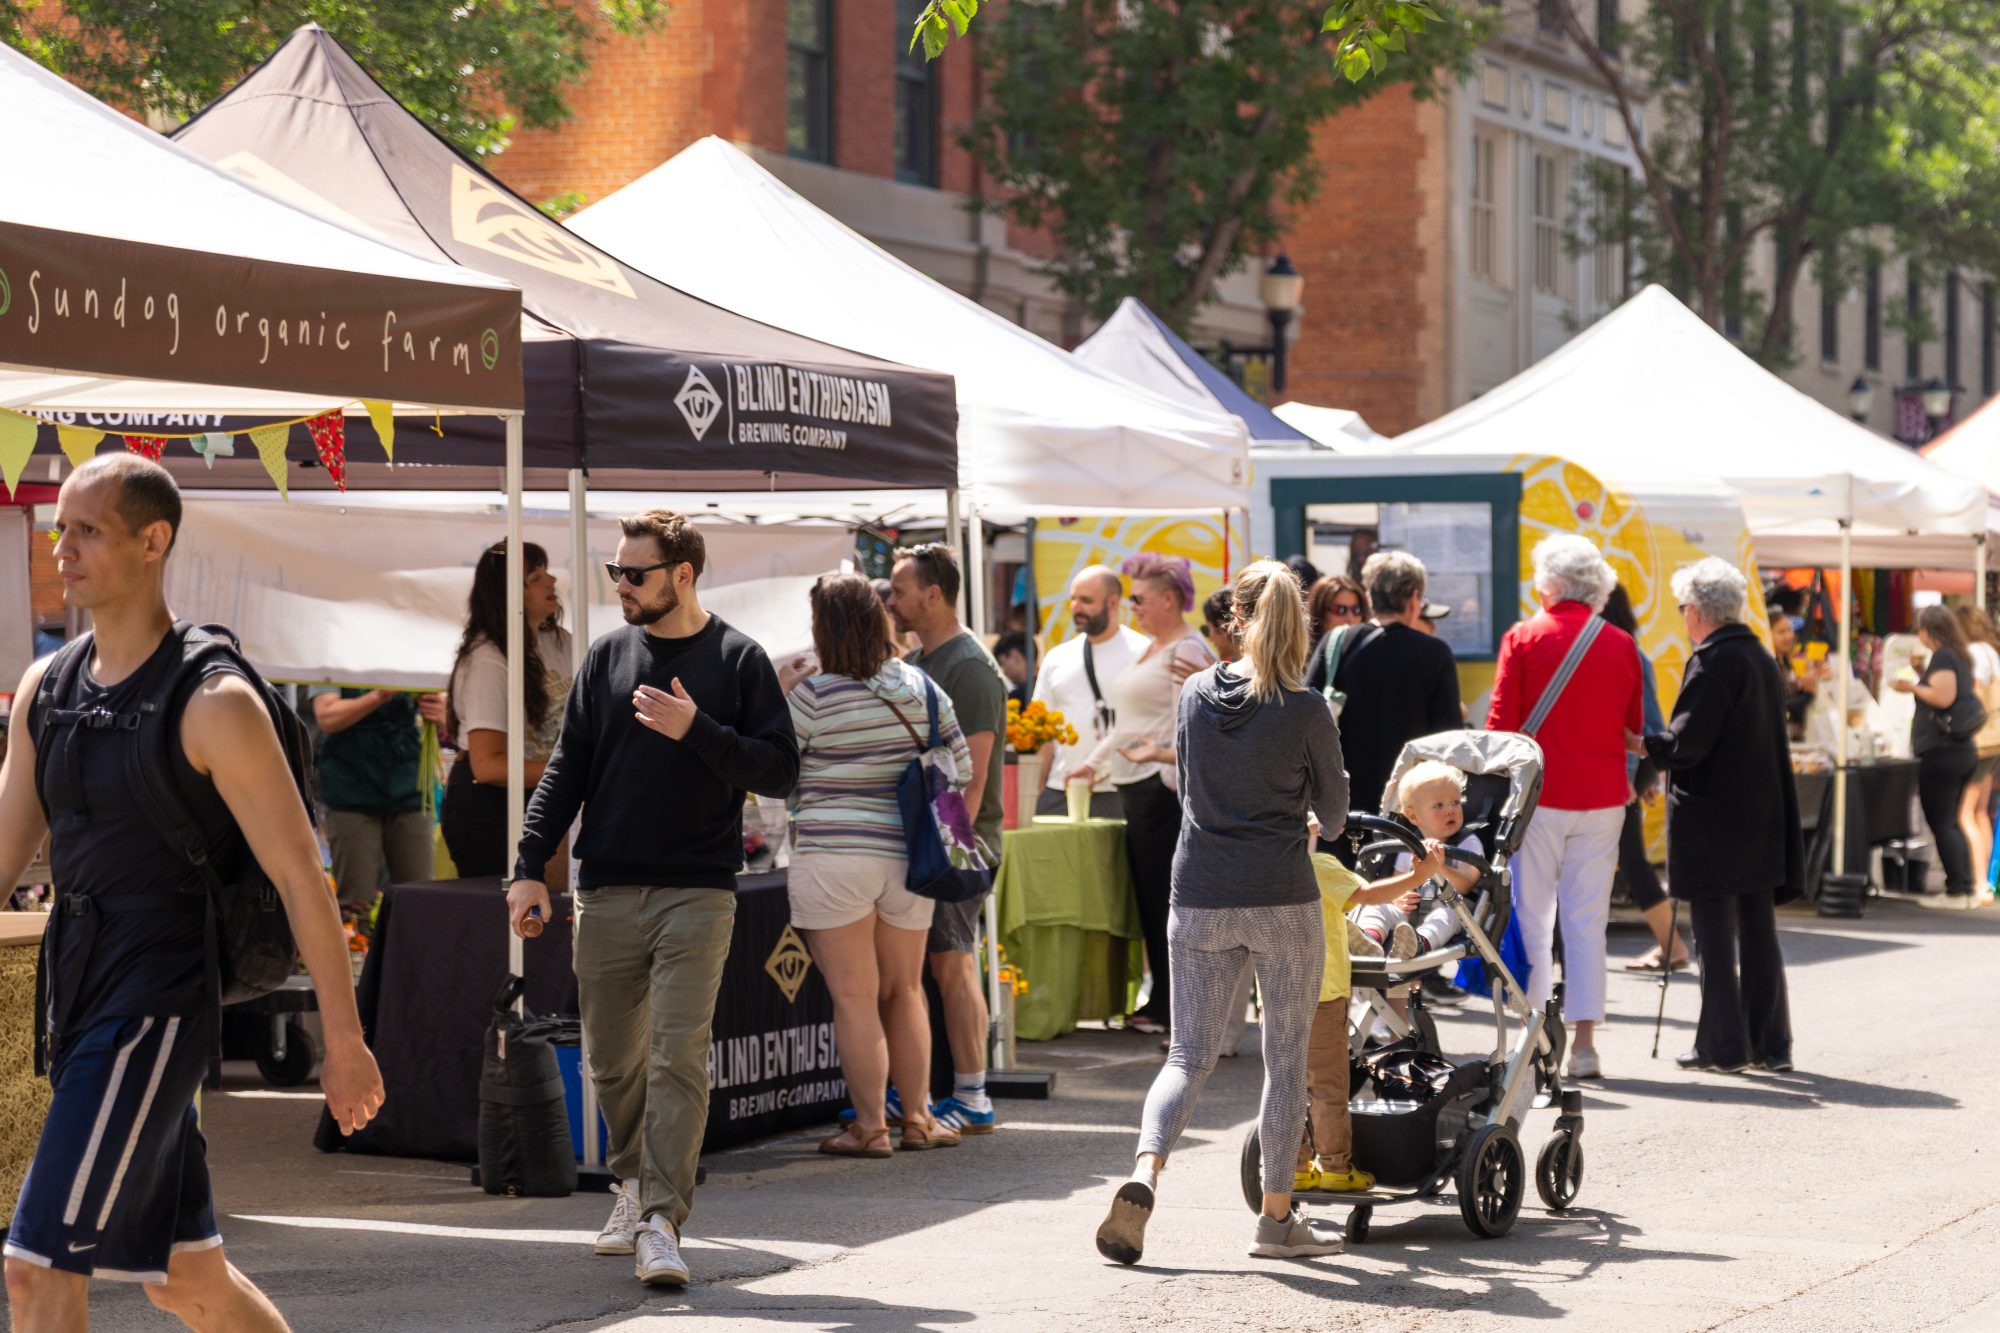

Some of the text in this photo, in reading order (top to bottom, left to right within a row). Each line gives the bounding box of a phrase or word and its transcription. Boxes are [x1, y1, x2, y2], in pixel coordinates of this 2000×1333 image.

[28, 270, 470, 374] Sundog organic farm
[734, 364, 892, 427] BLIND ENTHUSIASM
[739, 423, 847, 451] BREWING COMPANY
[763, 1022, 841, 1080] ENTHUSI
